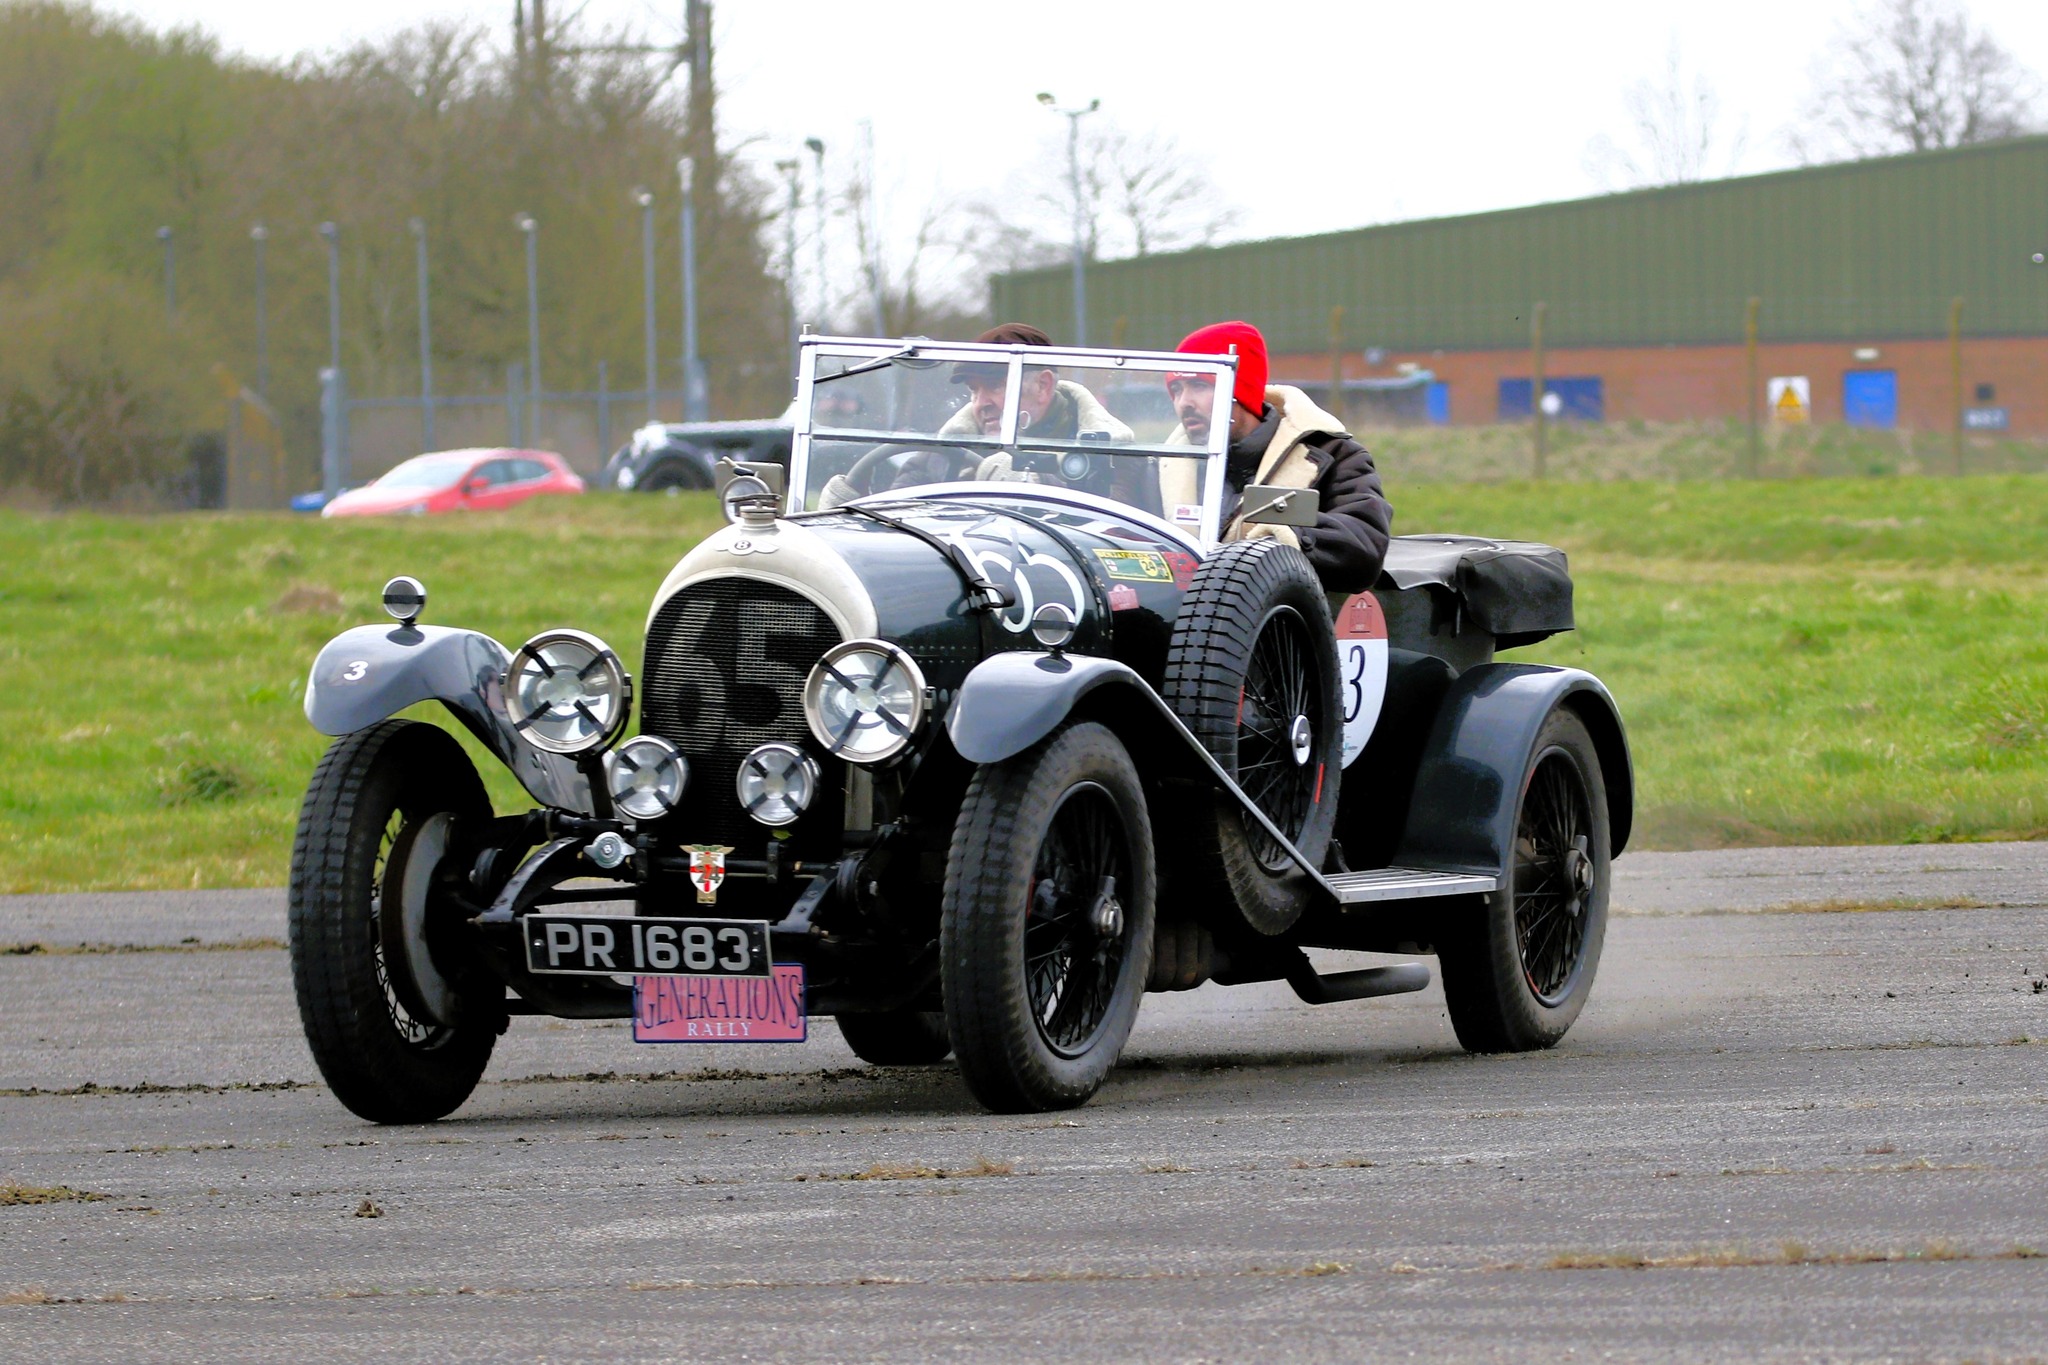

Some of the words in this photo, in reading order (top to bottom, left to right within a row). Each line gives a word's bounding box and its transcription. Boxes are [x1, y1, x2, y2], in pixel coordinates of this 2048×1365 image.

[1142, 559, 1157, 572] 24
[343, 660, 369, 680] 3
[650, 599, 818, 752] 65
[1343, 645, 1366, 723] 3
[545, 923, 615, 967] PR
[632, 924, 750, 970] 1683
[639, 973, 801, 1028] GENERATIONS
[687, 1021, 752, 1036] RALLY
